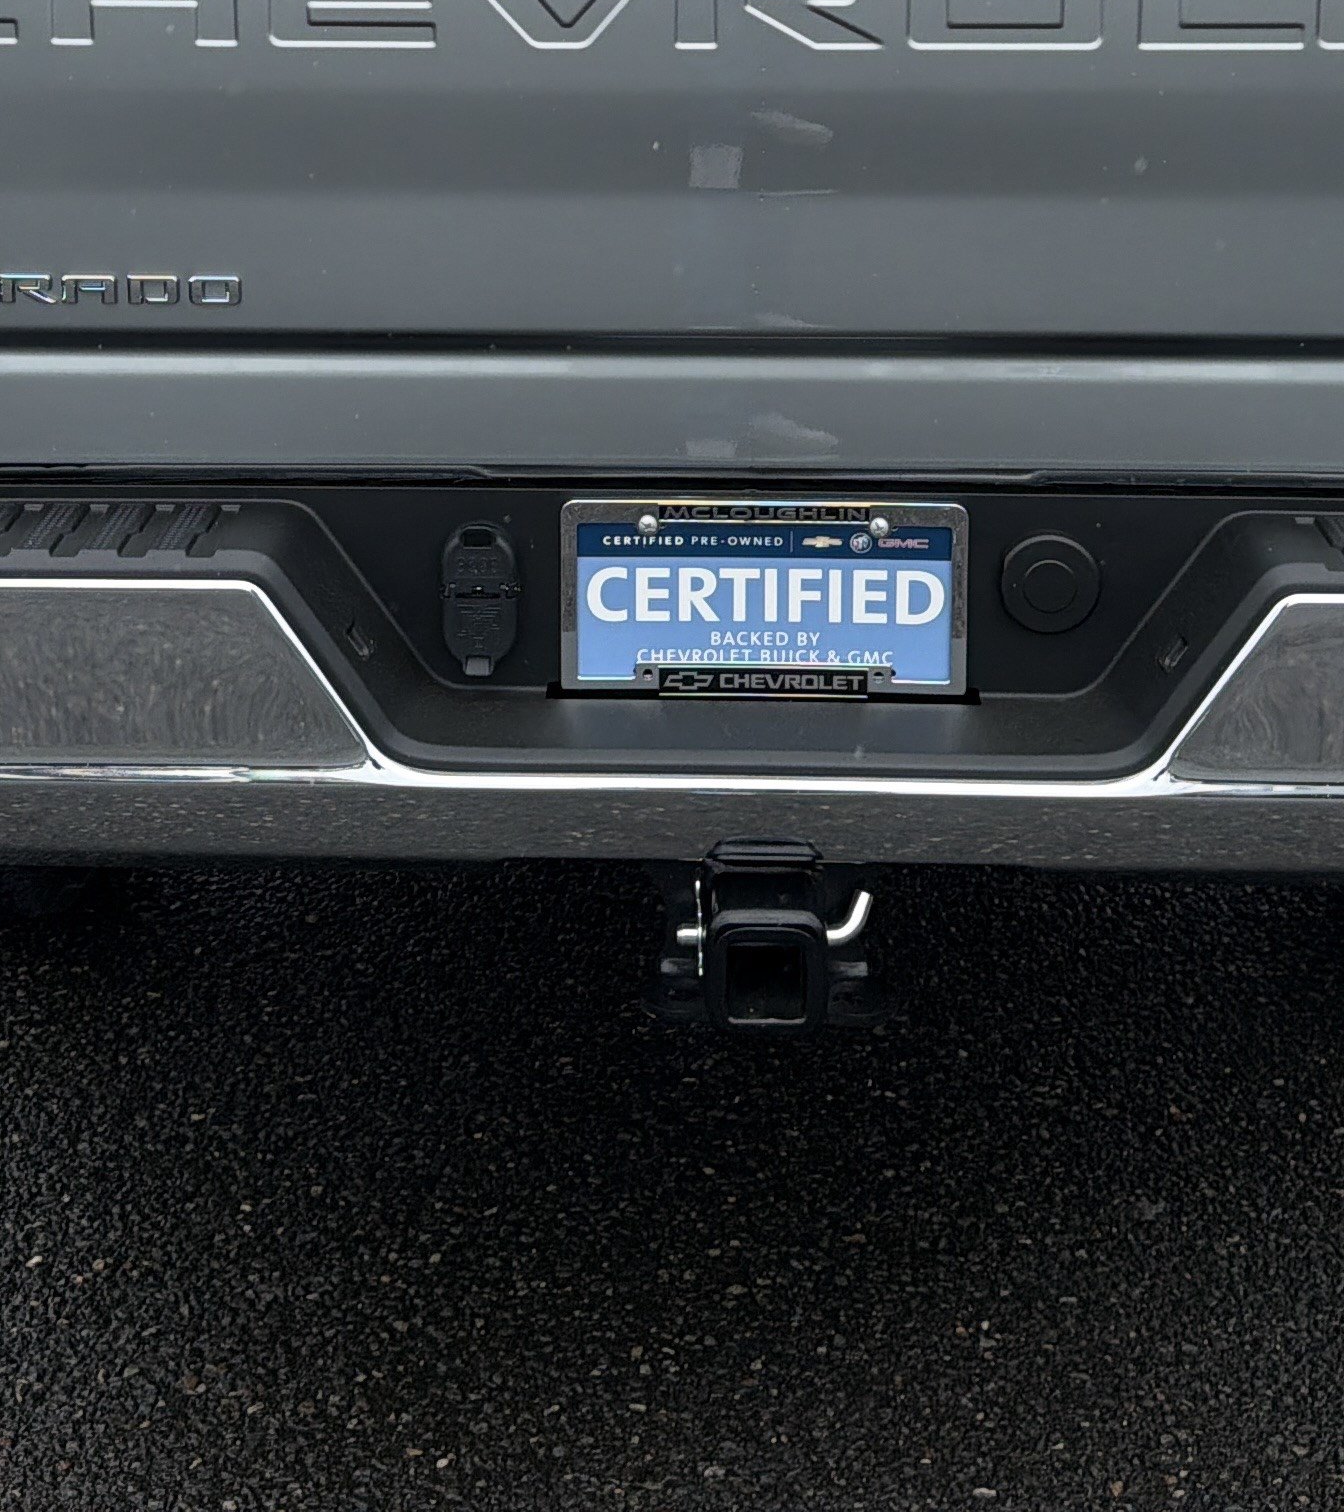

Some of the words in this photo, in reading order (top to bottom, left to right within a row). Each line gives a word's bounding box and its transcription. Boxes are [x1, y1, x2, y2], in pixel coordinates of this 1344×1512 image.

[602, 535, 684, 547] CERTIFIED
[691, 535, 784, 548] PRE-OWNED
[878, 538, 930, 549] GMC
[586, 566, 946, 626] CERTIFIED
[710, 631, 789, 647] BACKED
[797, 632, 820, 647] BY
[636, 648, 753, 663] CHEVROLET
[760, 649, 820, 663] BUICK
[848, 650, 894, 665] GMC
[719, 673, 865, 691] CHEVROLET
